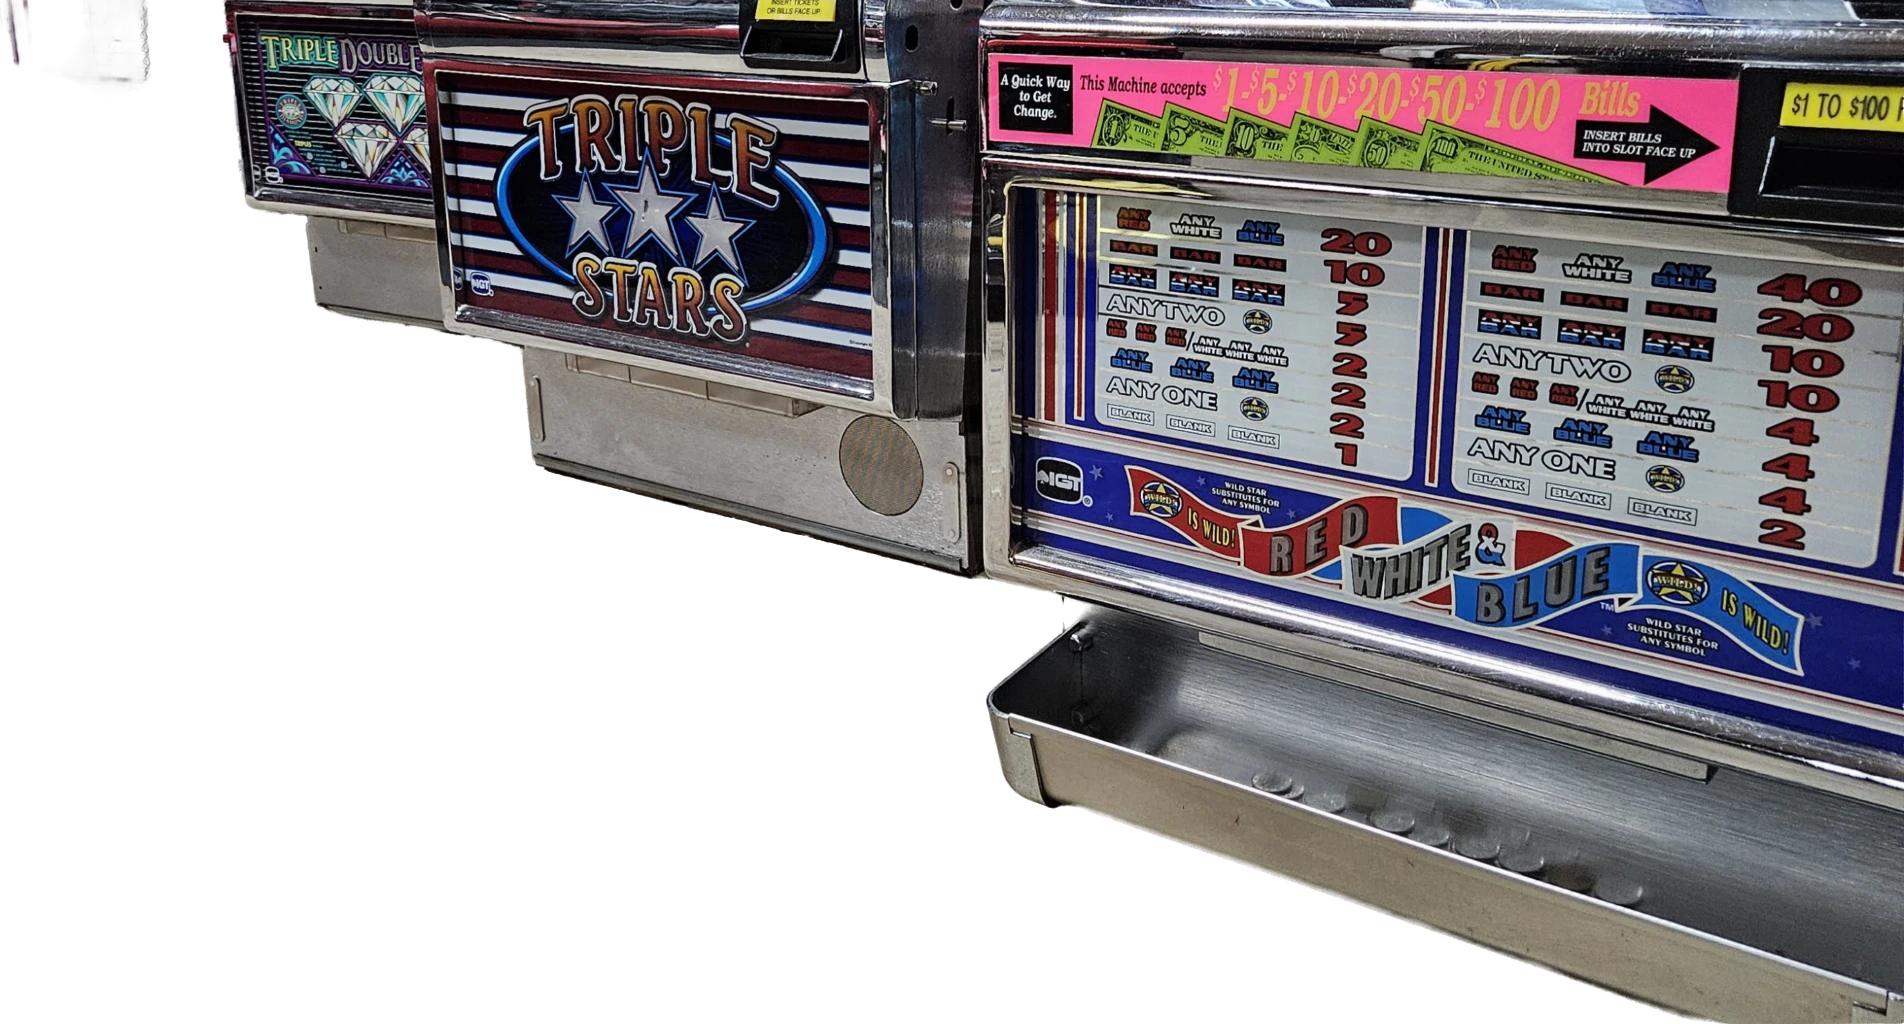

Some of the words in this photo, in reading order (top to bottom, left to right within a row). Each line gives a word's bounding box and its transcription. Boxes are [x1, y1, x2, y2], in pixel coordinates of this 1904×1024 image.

[258, 34, 339, 71] TRIPLE
[339, 37, 423, 76] DOUBLE
[1000, 74, 1009, 86] A
[1011, 73, 1042, 91] Quick
[1045, 76, 1071, 92] Way
[1018, 90, 1030, 102] to
[1032, 91, 1052, 104] Get
[1080, 74, 1104, 91] This
[1108, 76, 1158, 93] Machine
[1160, 76, 1207, 98] accepts
[1013, 104, 1058, 119] Change.
[1579, 80, 1641, 118] Bills
[1791, 91, 1810, 115] $1
[1818, 93, 1841, 117] TO
[1849, 94, 1891, 121] $100
[1582, 142, 1610, 156] INTO
[1613, 143, 1642, 156] SLOT
[1645, 145, 1677, 158] FACE
[1679, 148, 1696, 160] UP
[1583, 129, 1625, 143] INSERT
[1628, 131, 1662, 144] BILLS
[524, 93, 779, 210] TRIPLE
[1320, 227, 1393, 258] 20
[1323, 259, 1385, 287] 10
[572, 252, 747, 343] STARS
[1335, 290, 1369, 316] 5
[1756, 273, 1863, 308] 40
[1756, 307, 1855, 343] 20
[1472, 343, 1546, 373] ANY
[1547, 350, 1632, 384] TWO
[1761, 344, 1845, 379] 10
[1330, 382, 1367, 409] 2
[1110, 407, 1152, 424] BLANK
[1329, 412, 1365, 439] 2
[1334, 442, 1359, 467] 1
[1050, 474, 1082, 491] IGT
[1632, 501, 1693, 522] BLANK
[1758, 486, 1812, 516] 4
[1187, 506, 1199, 532] IS
[1202, 522, 1236, 549] WILD!
[1268, 504, 1369, 574] RED
[1758, 519, 1806, 550] 2
[1351, 523, 1472, 600] WHITE
[1475, 522, 1506, 567] &
[1475, 545, 1611, 626] BLUE
[1627, 623, 1694, 644] SUBSTITUTES
[1696, 638, 1719, 650] FOR
[1645, 617, 1673, 629] WILD
[1674, 622, 1702, 635] STAR
[1720, 589, 1737, 617] IS
[1742, 602, 1790, 656] WILD!
[1640, 635, 1663, 647] ANY
[1664, 640, 1707, 657] SYMBOL
